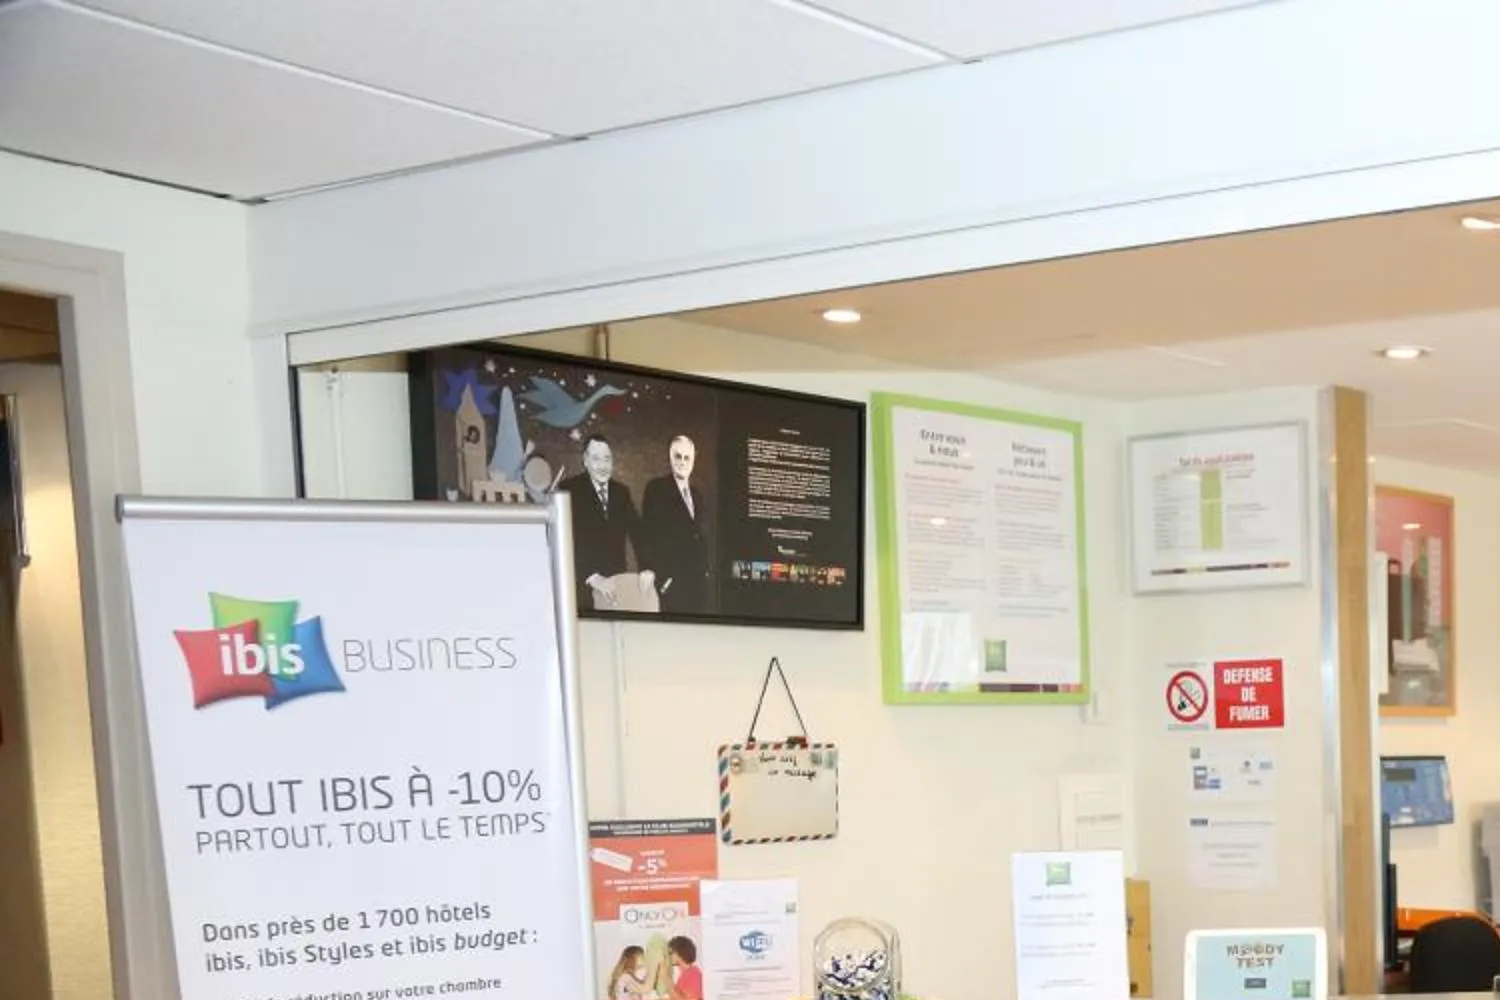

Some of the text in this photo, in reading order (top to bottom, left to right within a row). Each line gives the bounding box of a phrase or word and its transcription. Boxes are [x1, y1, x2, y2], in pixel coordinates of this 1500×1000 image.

[219, 632, 517, 676] ibis BUSINESS
[1223, 667, 1273, 684] DEFENSE
[1241, 686, 1256, 702] DE
[1229, 705, 1269, 721] FUMER
[186, 765, 542, 819] TOUT IBIS À -10%
[195, 824, 333, 855] PARTOUT,
[340, 819, 411, 846] TOUT
[421, 816, 451, 841] LE
[202, 922, 260, 943] Dans
[267, 916, 316, 940] près
[322, 912, 350, 932] de
[426, 902, 491, 924] hôtels
[206, 952, 252, 972] ibis,
[258, 946, 297, 968] ibis
[304, 942, 375, 965] Styles
[380, 938, 404, 957] et
[409, 934, 446, 954] ibis
[1237, 957, 1273, 969] TEST
[367, 988, 390, 1000] sur
[395, 982, 435, 998] votre
[439, 976, 502, 993] chambre
